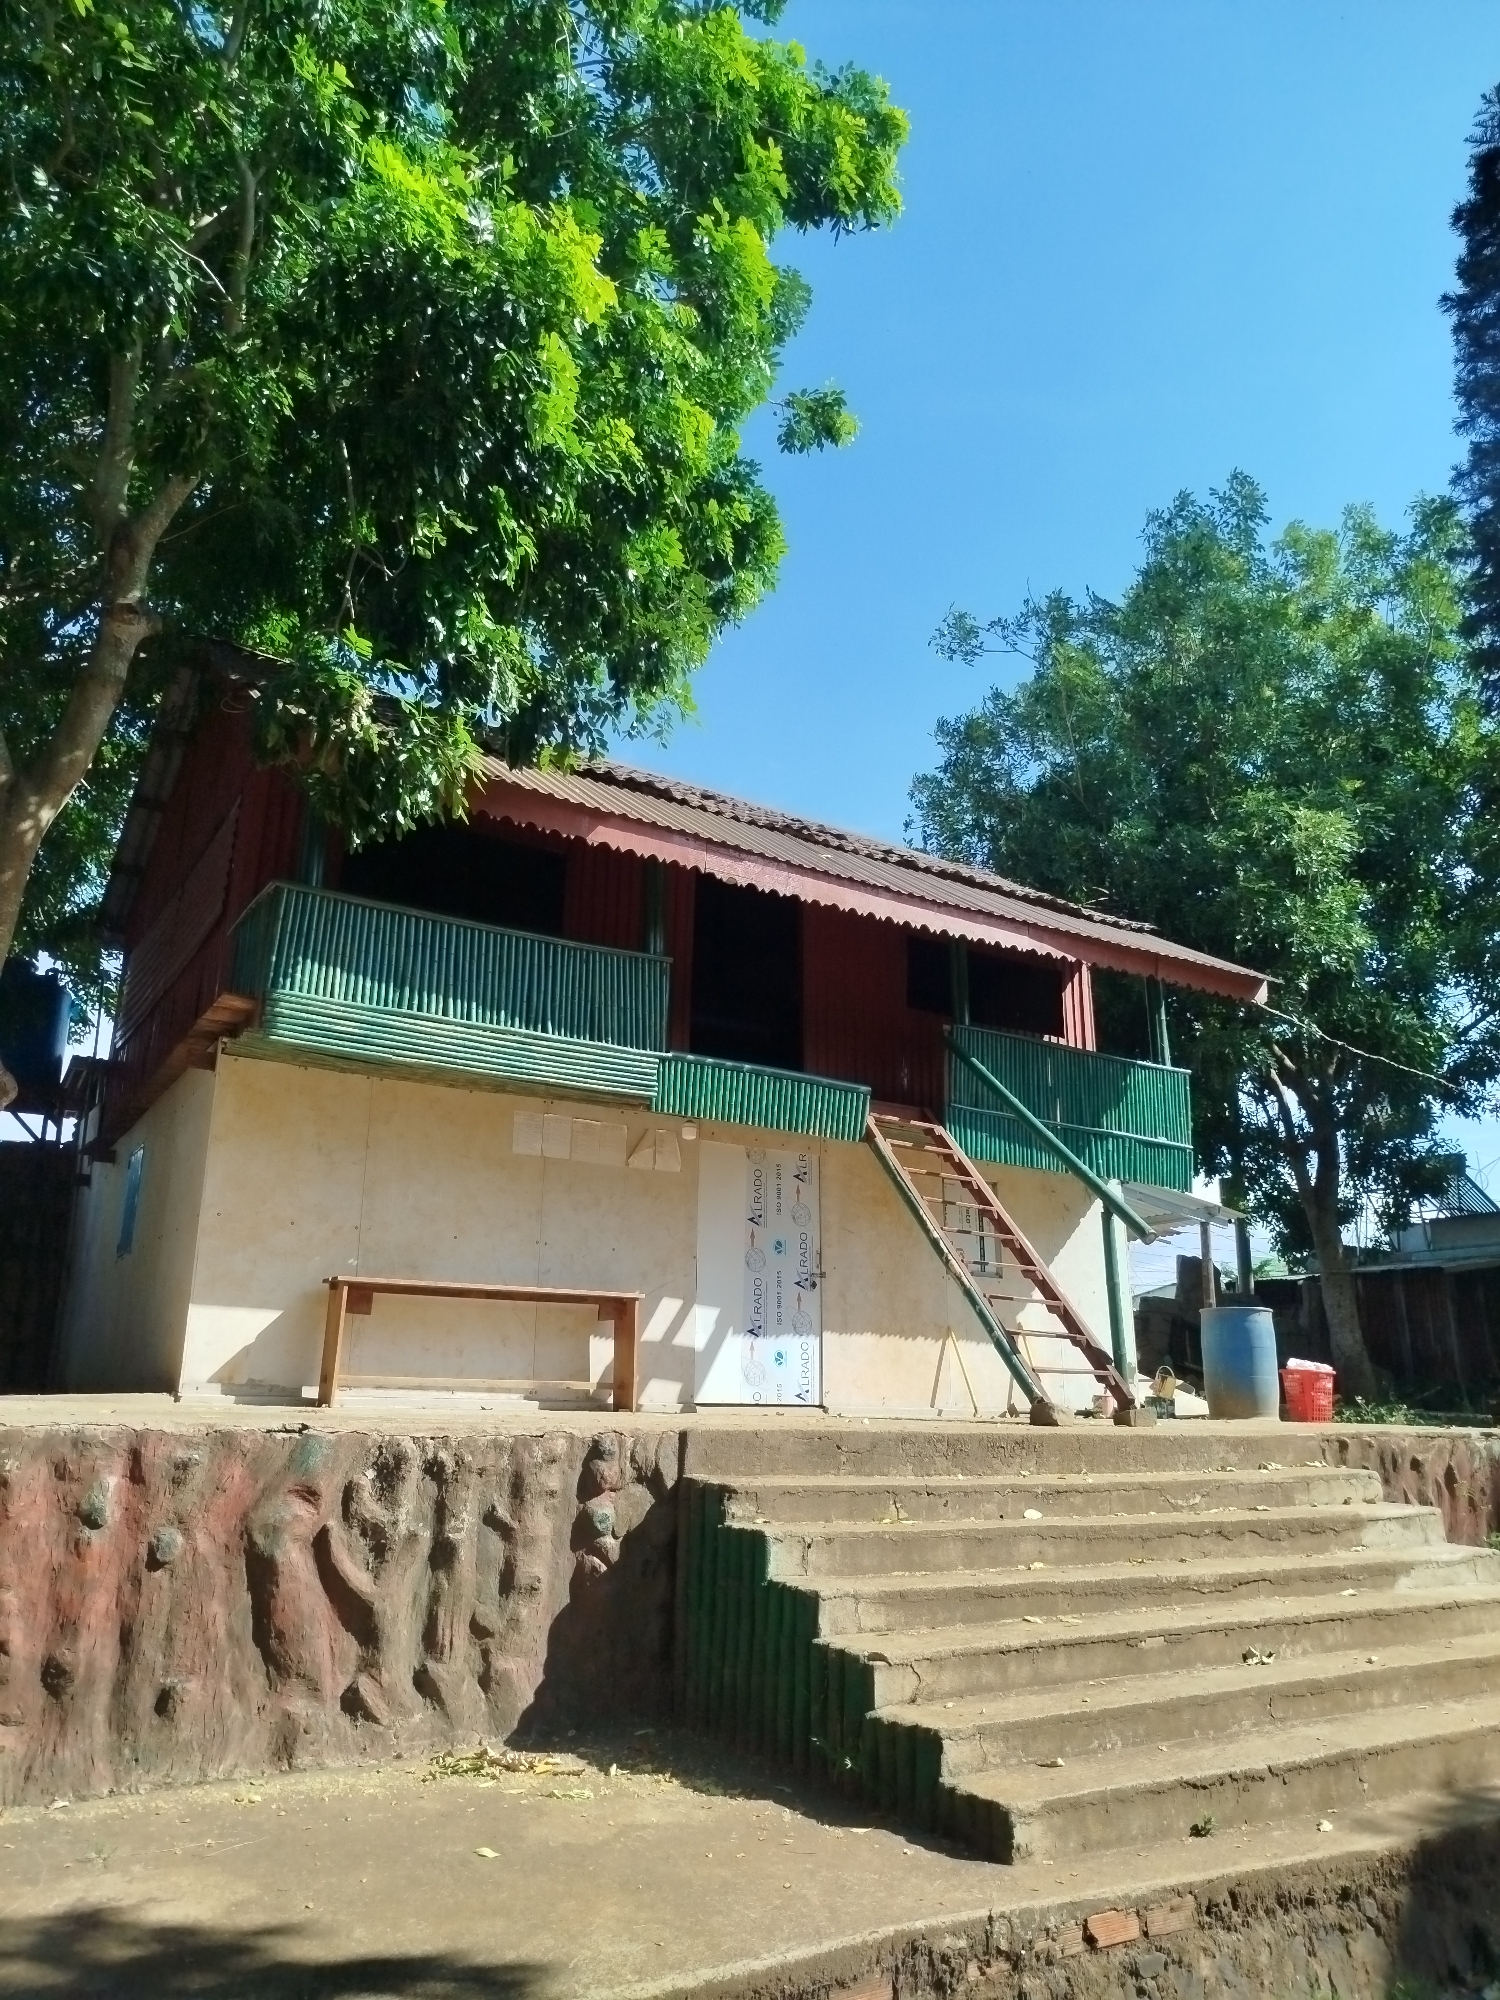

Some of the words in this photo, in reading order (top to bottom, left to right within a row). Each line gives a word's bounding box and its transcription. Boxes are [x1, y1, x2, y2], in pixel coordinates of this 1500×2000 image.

[747, 1168, 763, 1228] ALRADO
[793, 1232, 809, 1292] ALRADO
[746, 1277, 763, 1338] ALRADO
[794, 1341, 810, 1403] ALRADO
